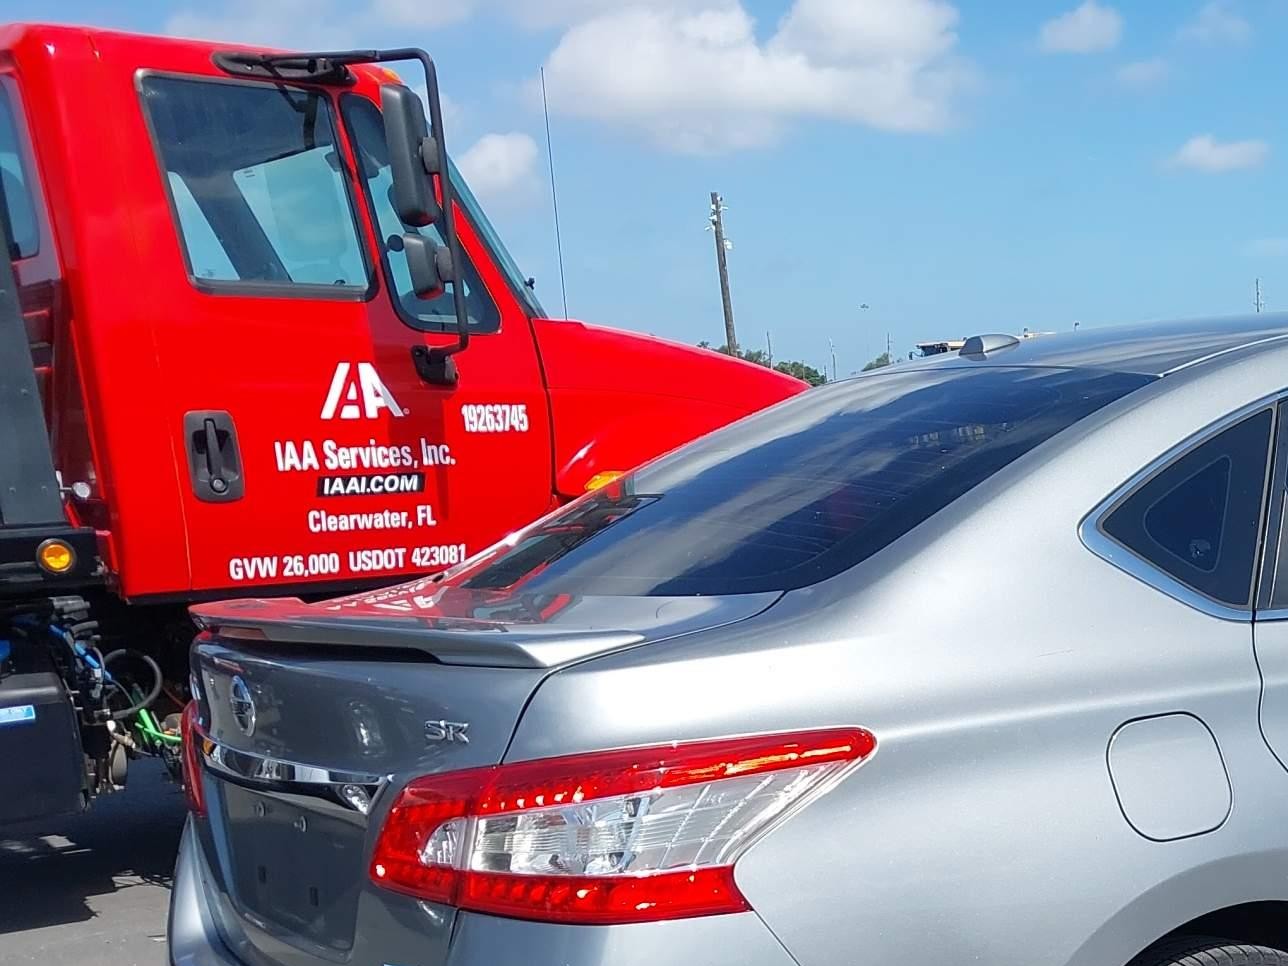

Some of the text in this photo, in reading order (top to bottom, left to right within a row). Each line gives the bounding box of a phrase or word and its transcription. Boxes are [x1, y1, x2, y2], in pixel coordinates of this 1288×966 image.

[461, 404, 528, 432] 19263745
[274, 437, 456, 472] IAA Services, Inc.
[323, 475, 418, 495] IAAI.COM
[308, 505, 436, 533] Clearwater, FL
[229, 543, 466, 580] GVW 26,000 USDOT 423081
[425, 720, 470, 743] SR
